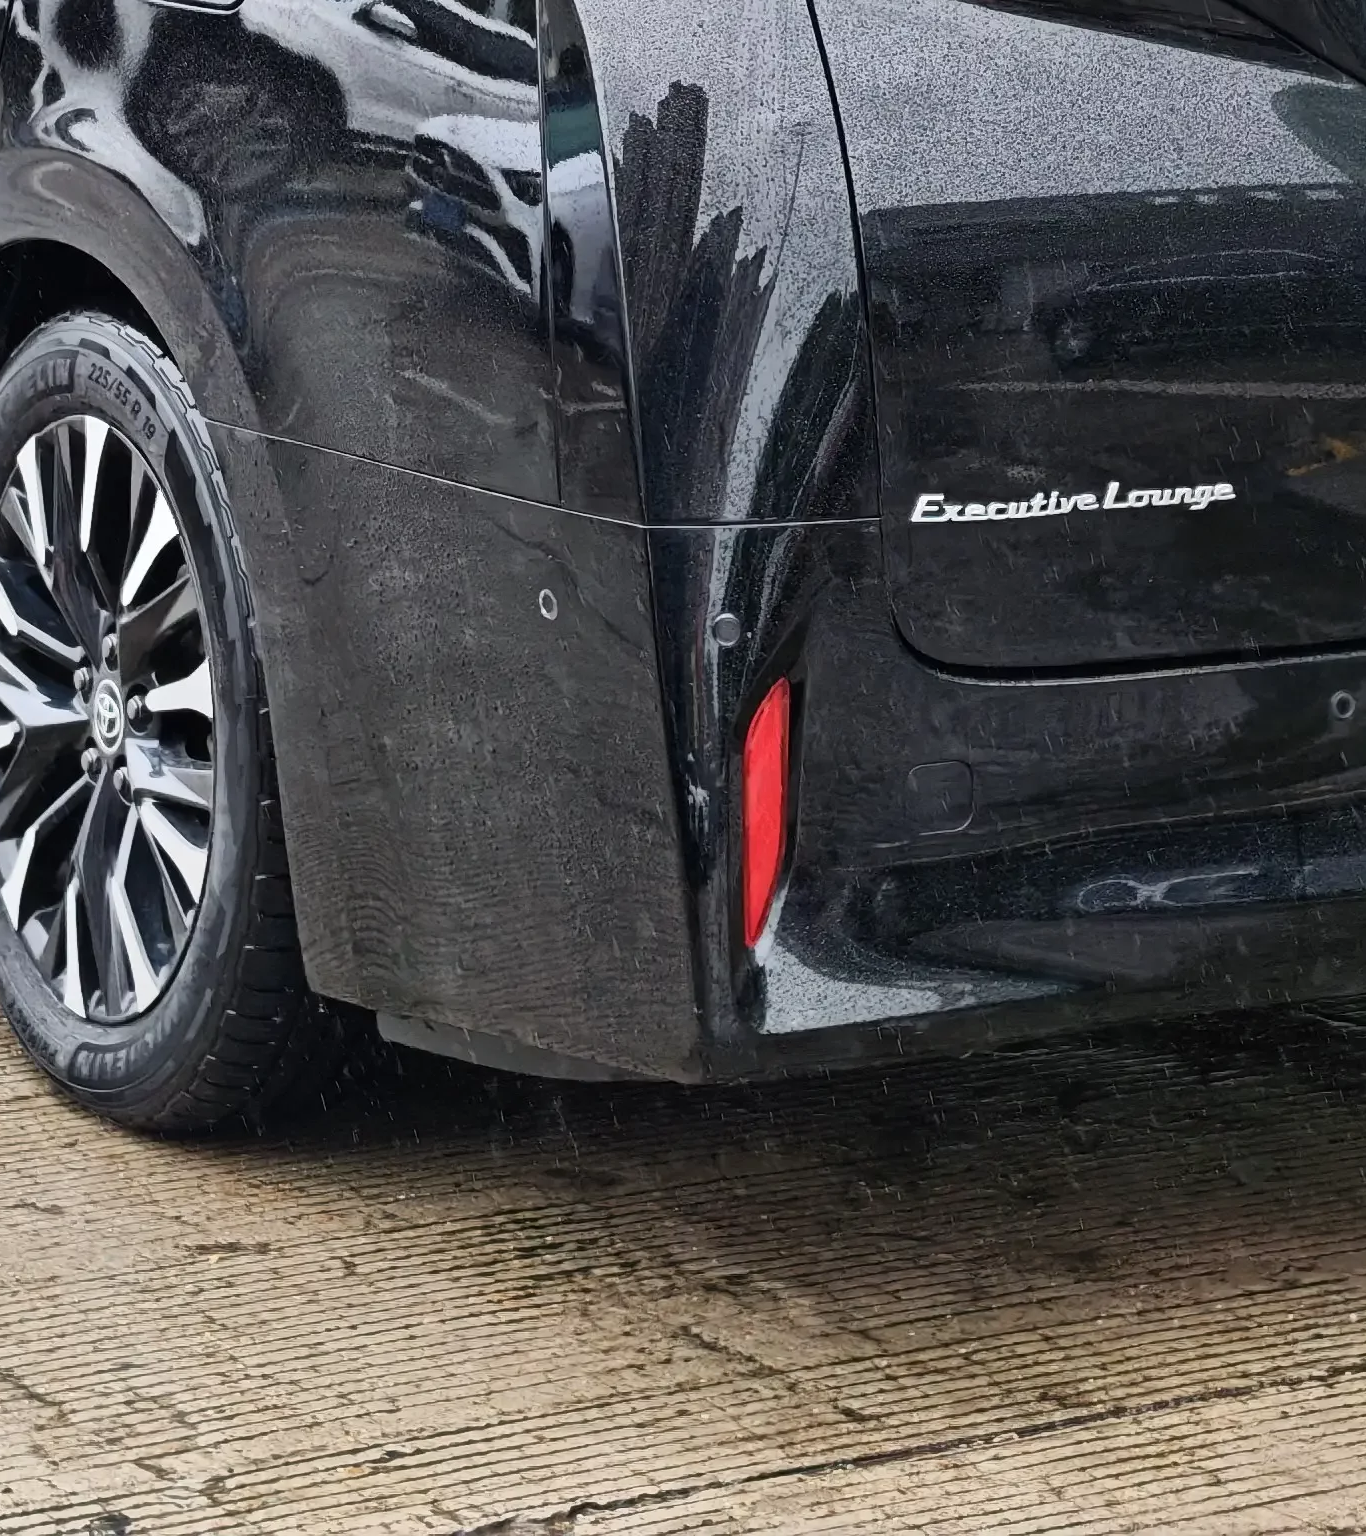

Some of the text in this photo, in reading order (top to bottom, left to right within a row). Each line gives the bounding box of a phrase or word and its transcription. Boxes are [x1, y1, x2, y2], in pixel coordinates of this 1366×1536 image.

[88, 362, 156, 440] 225/55 R 19
[910, 480, 1237, 523] Executive Lounge
